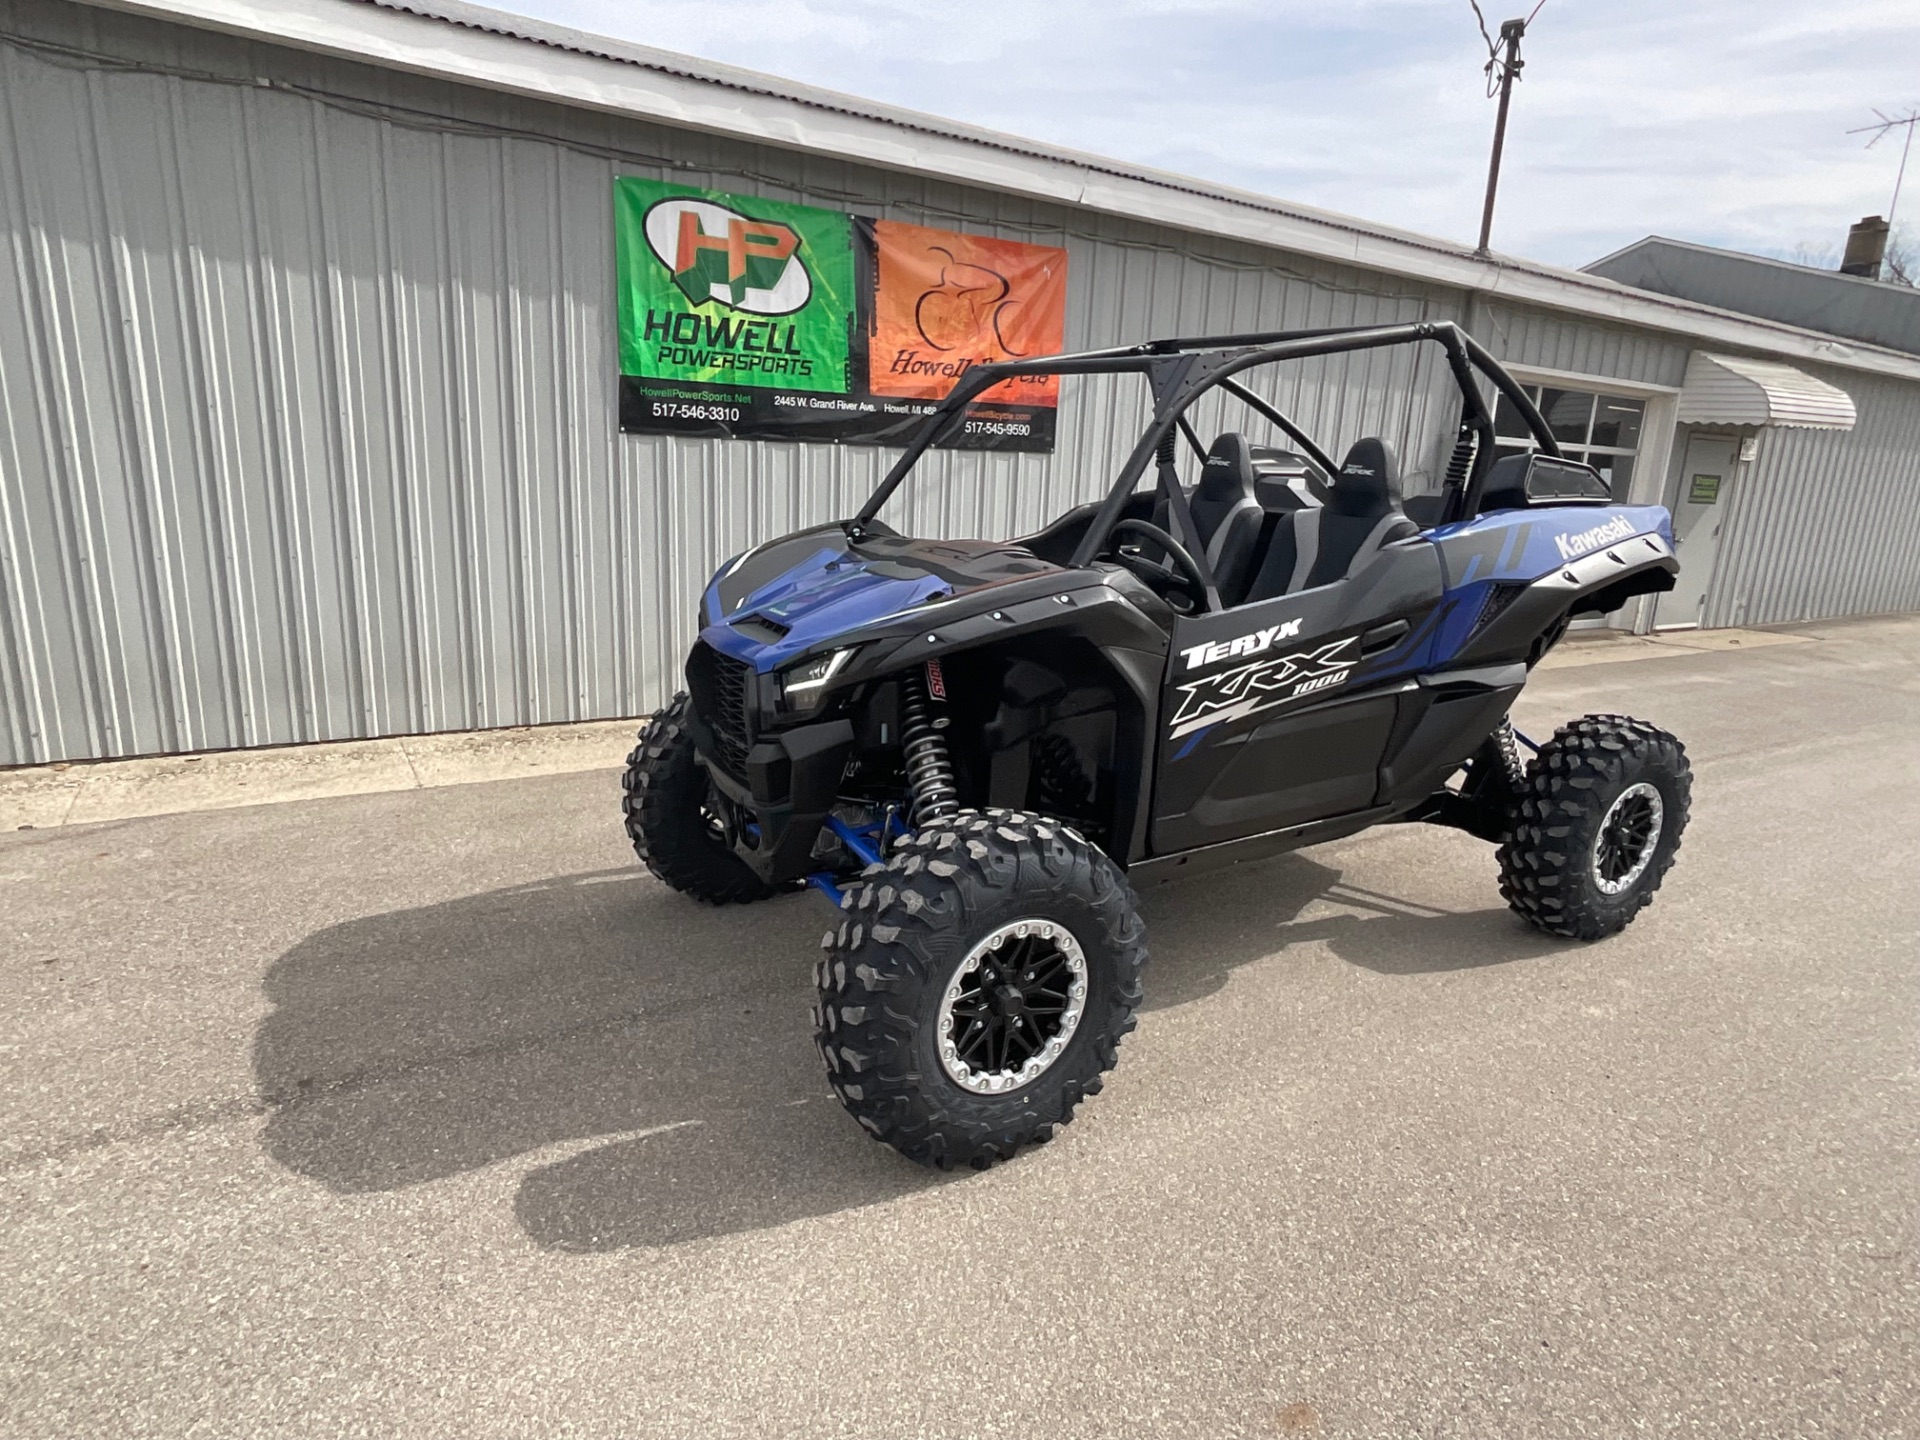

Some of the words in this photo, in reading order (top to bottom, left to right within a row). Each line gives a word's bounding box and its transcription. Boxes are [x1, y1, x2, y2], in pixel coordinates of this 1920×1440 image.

[644, 309, 801, 355] HOWELL
[658, 345, 813, 376] POWERSPORTS
[889, 349, 974, 379] Howell
[640, 386, 751, 403] HowellPowerSports.Net
[774, 395, 796, 407] 2445
[796, 396, 808, 408] W.
[809, 398, 835, 410] Grand
[836, 399, 858, 411] River
[858, 401, 876, 412] Ave.
[652, 402, 740, 422] 517-546-3310
[964, 421, 1031, 436] 517-545-9590
[1554, 514, 1637, 560] Kawasaki
[1180, 617, 1303, 670] TERYX
[1292, 669, 1350, 696] 1000
